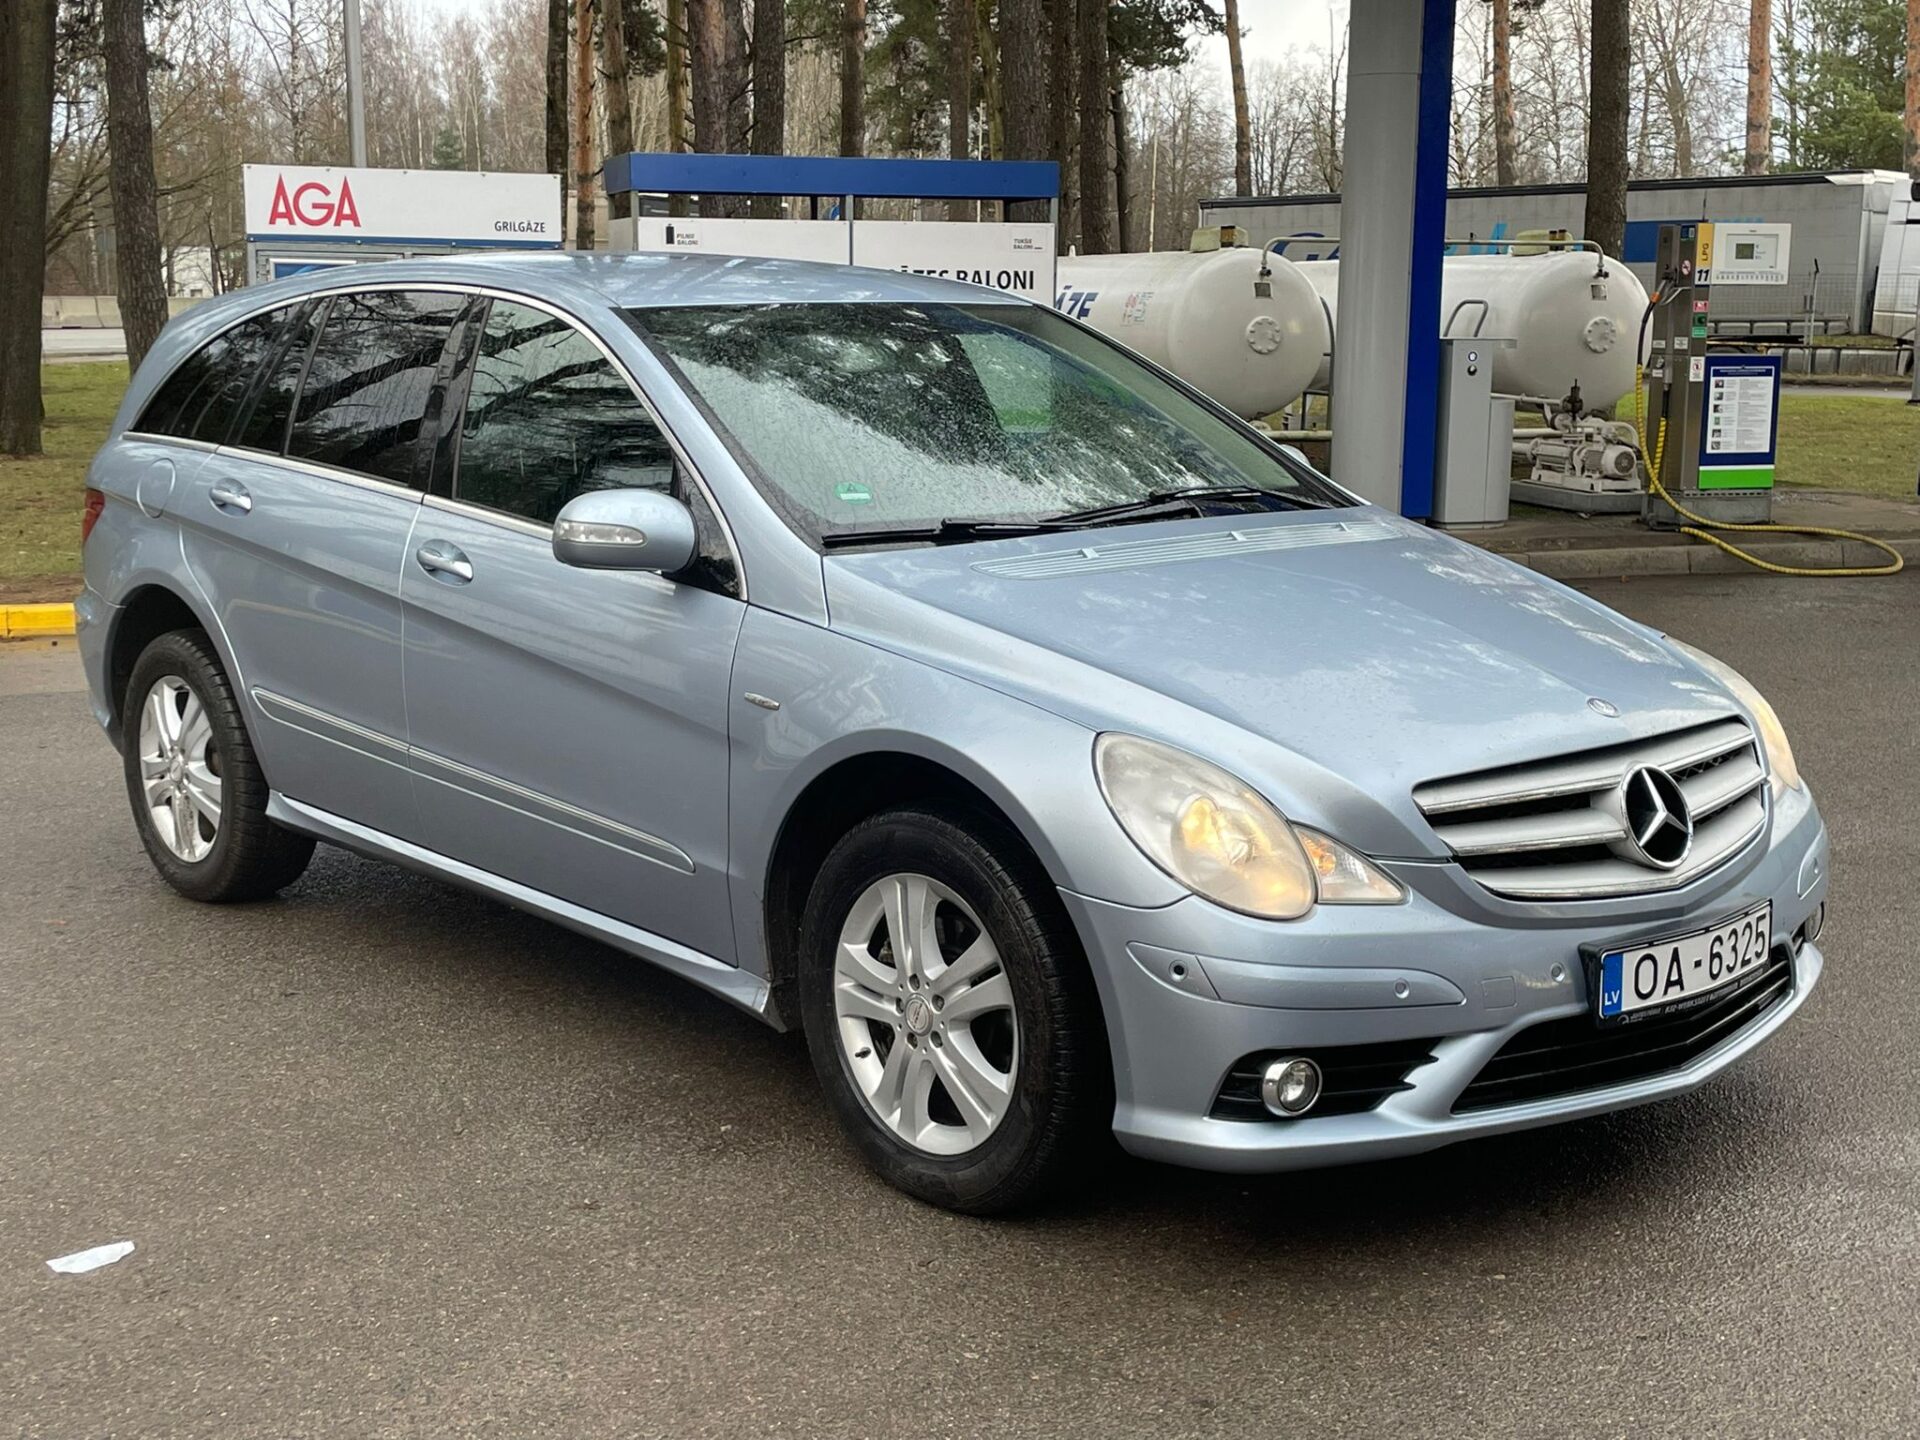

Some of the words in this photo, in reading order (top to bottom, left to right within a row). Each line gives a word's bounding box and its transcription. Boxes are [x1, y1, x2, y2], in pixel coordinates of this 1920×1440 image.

[268, 173, 362, 227] AGA
[956, 270, 1034, 290] BALONI
[1697, 269, 1710, 281] 11
[1633, 914, 1767, 1000] OA-6325
[1604, 989, 1620, 1006] LV
